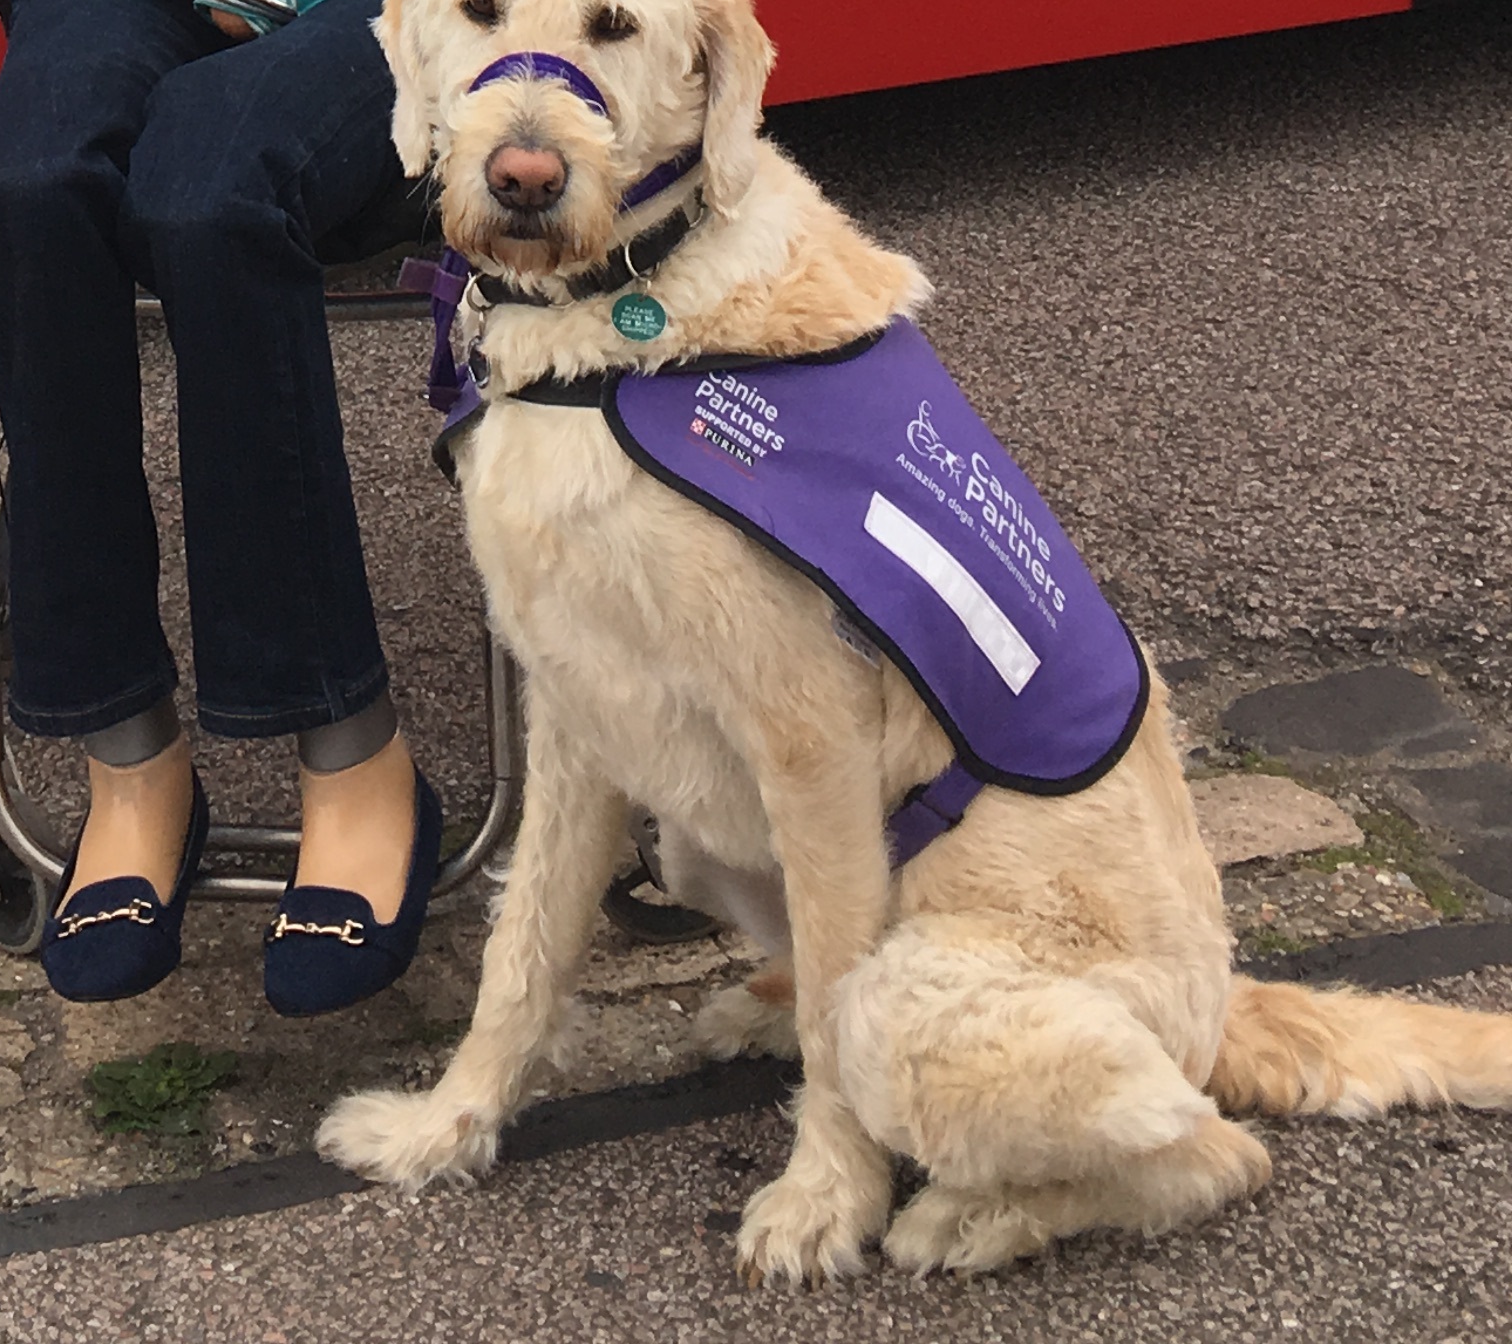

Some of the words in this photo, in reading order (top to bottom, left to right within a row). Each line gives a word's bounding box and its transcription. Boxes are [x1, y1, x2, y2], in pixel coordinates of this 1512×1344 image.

[694, 379, 785, 451] Partners
[694, 404, 752, 448] SUPPORTED
[752, 443, 768, 458] BY
[704, 427, 752, 467] PURINA
[896, 453, 947, 503] Amazing
[979, 525, 1037, 603] Transforming
[965, 475, 1066, 612] Partners
[971, 452, 1051, 561] Canine
